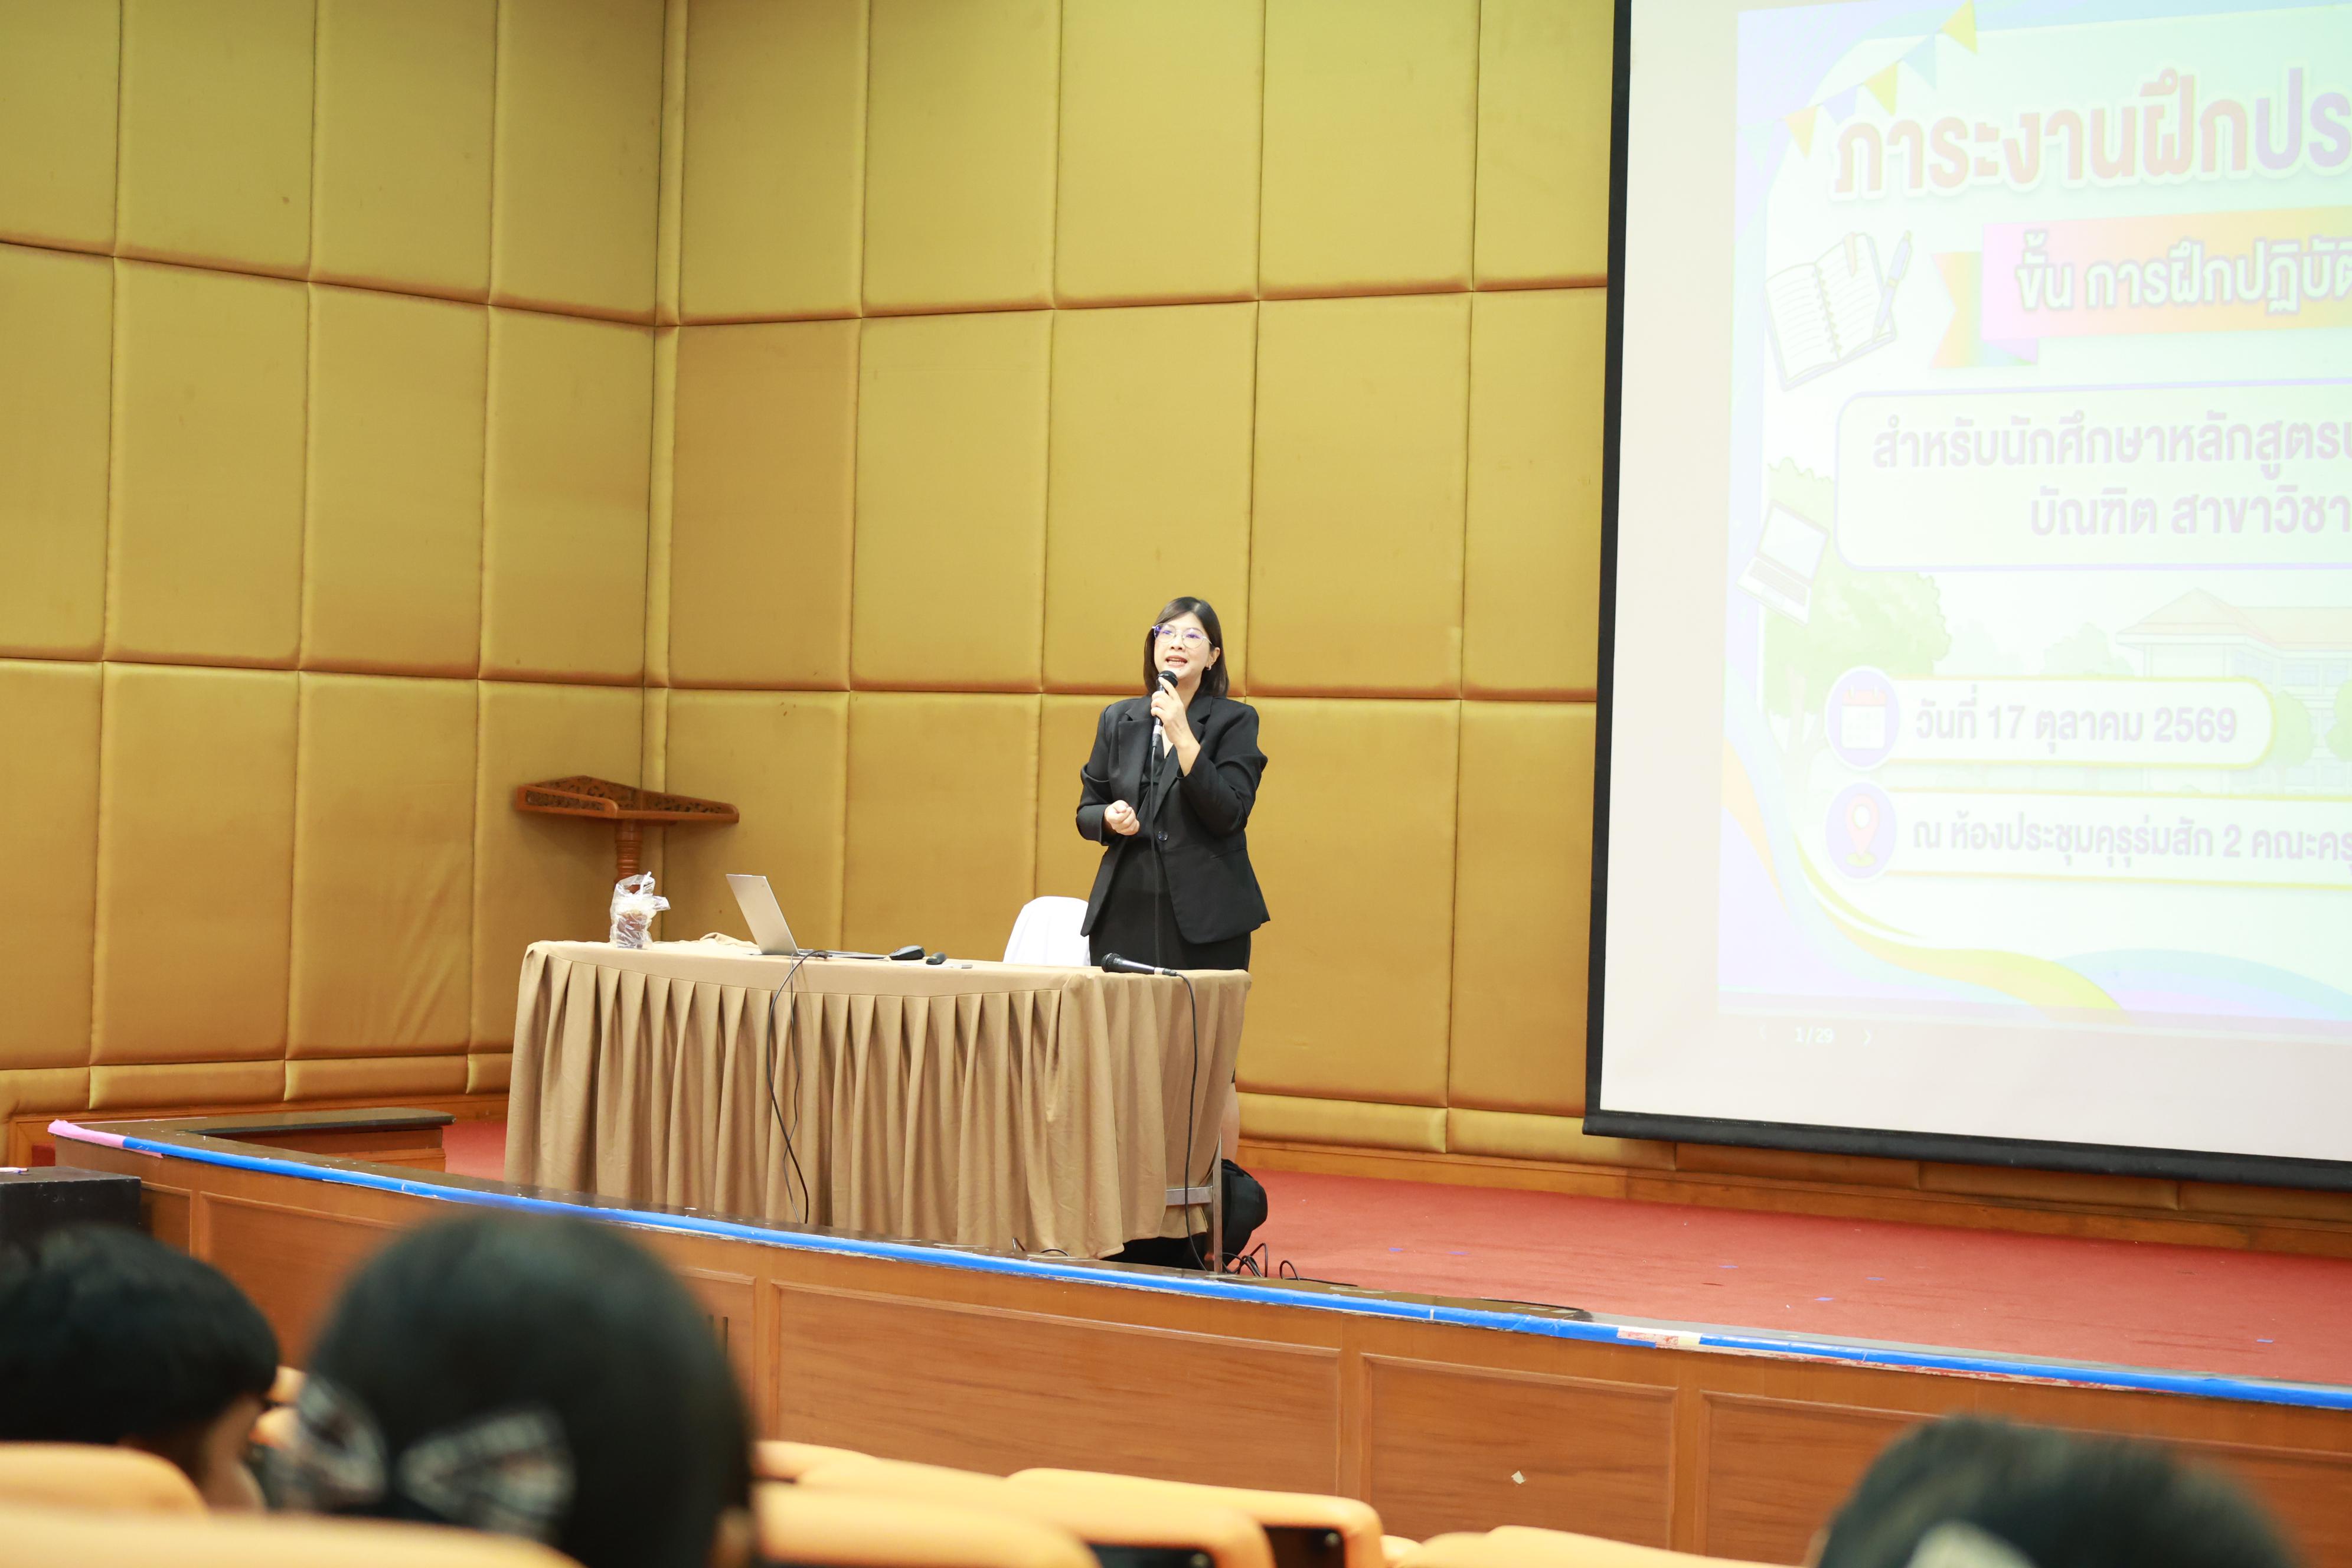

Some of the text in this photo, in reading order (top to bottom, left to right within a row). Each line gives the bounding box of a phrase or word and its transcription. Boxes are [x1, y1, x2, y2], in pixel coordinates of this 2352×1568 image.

[1834, 67, 2352, 193] ภาระงานฝึกปร
[2014, 230, 2073, 309] ขั้น
[2031, 484, 2351, 535] บัณฑิต สาขาวิชา
[1916, 683, 2237, 754] วันที่ 17 ตุลาคม 2569
[1913, 820, 1941, 849] ณ
[2223, 823, 2242, 857] 2
